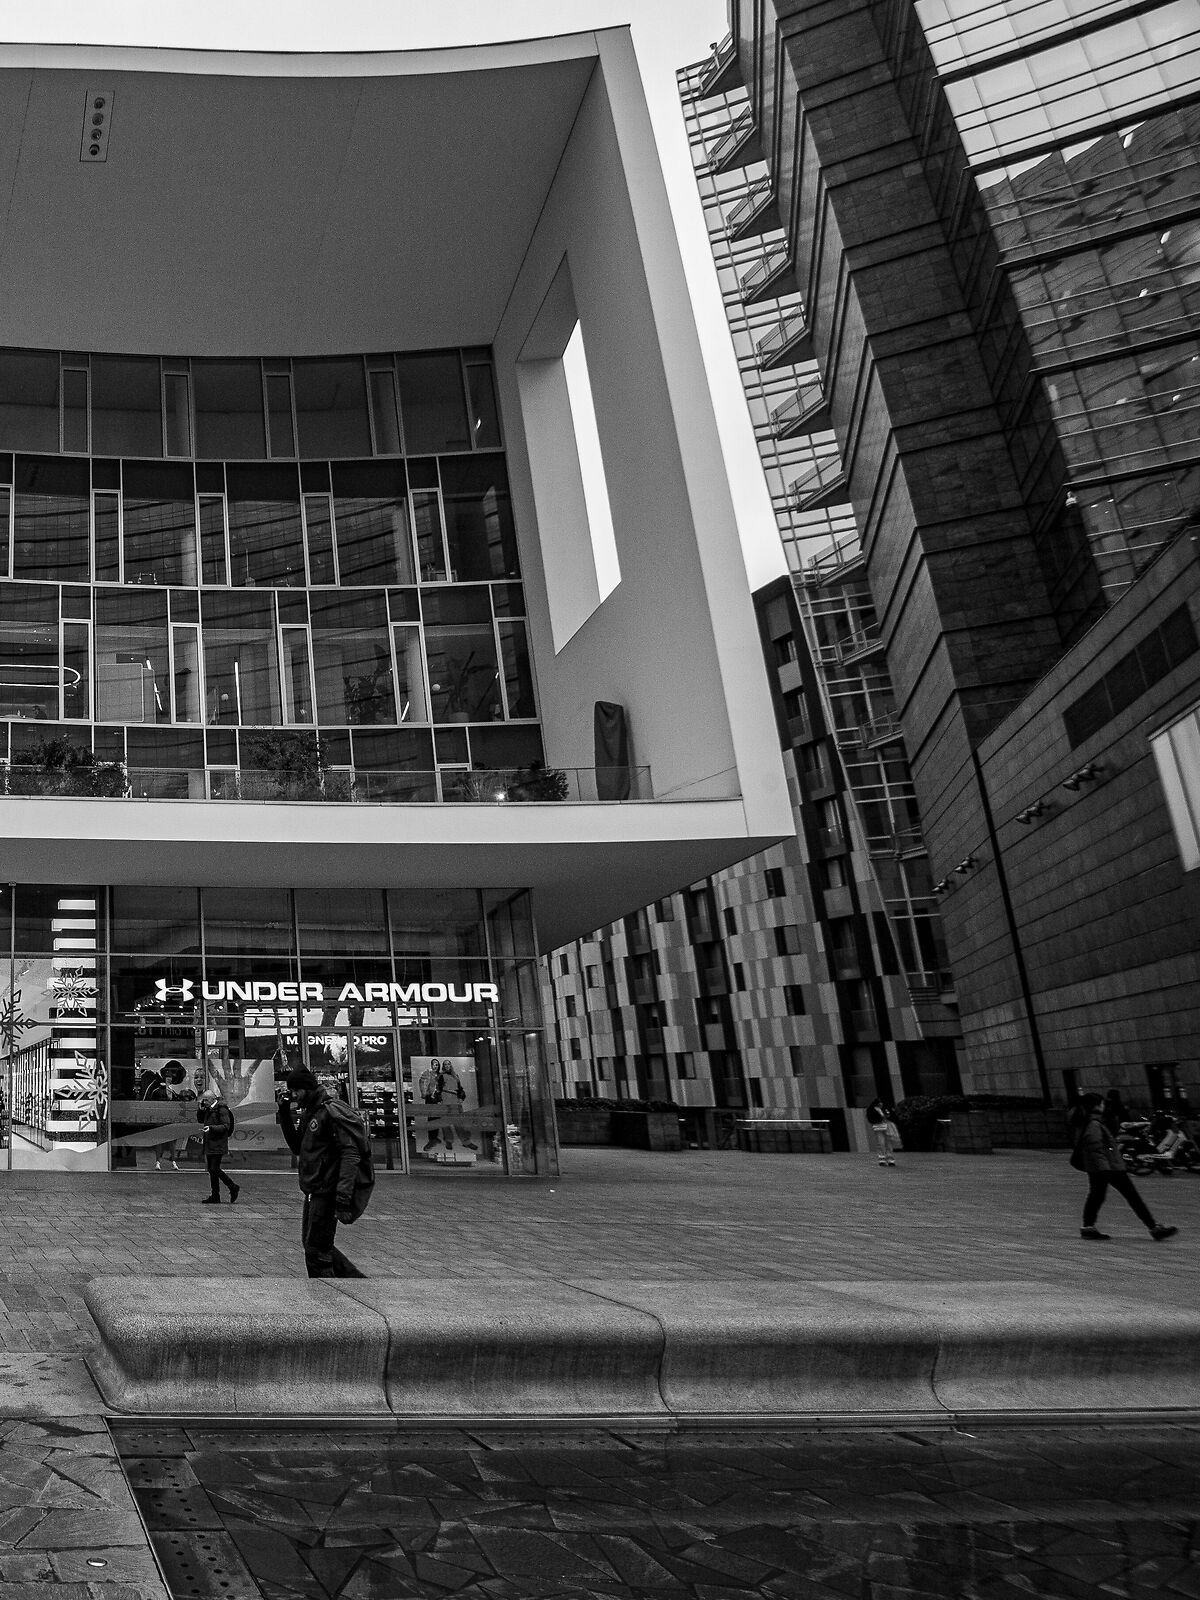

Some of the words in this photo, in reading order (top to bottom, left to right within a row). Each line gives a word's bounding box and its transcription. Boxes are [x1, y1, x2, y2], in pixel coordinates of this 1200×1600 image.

[201, 981, 324, 1002] UNDER
[337, 982, 499, 1003] ARMOUR
[362, 1035, 388, 1046] PRO
